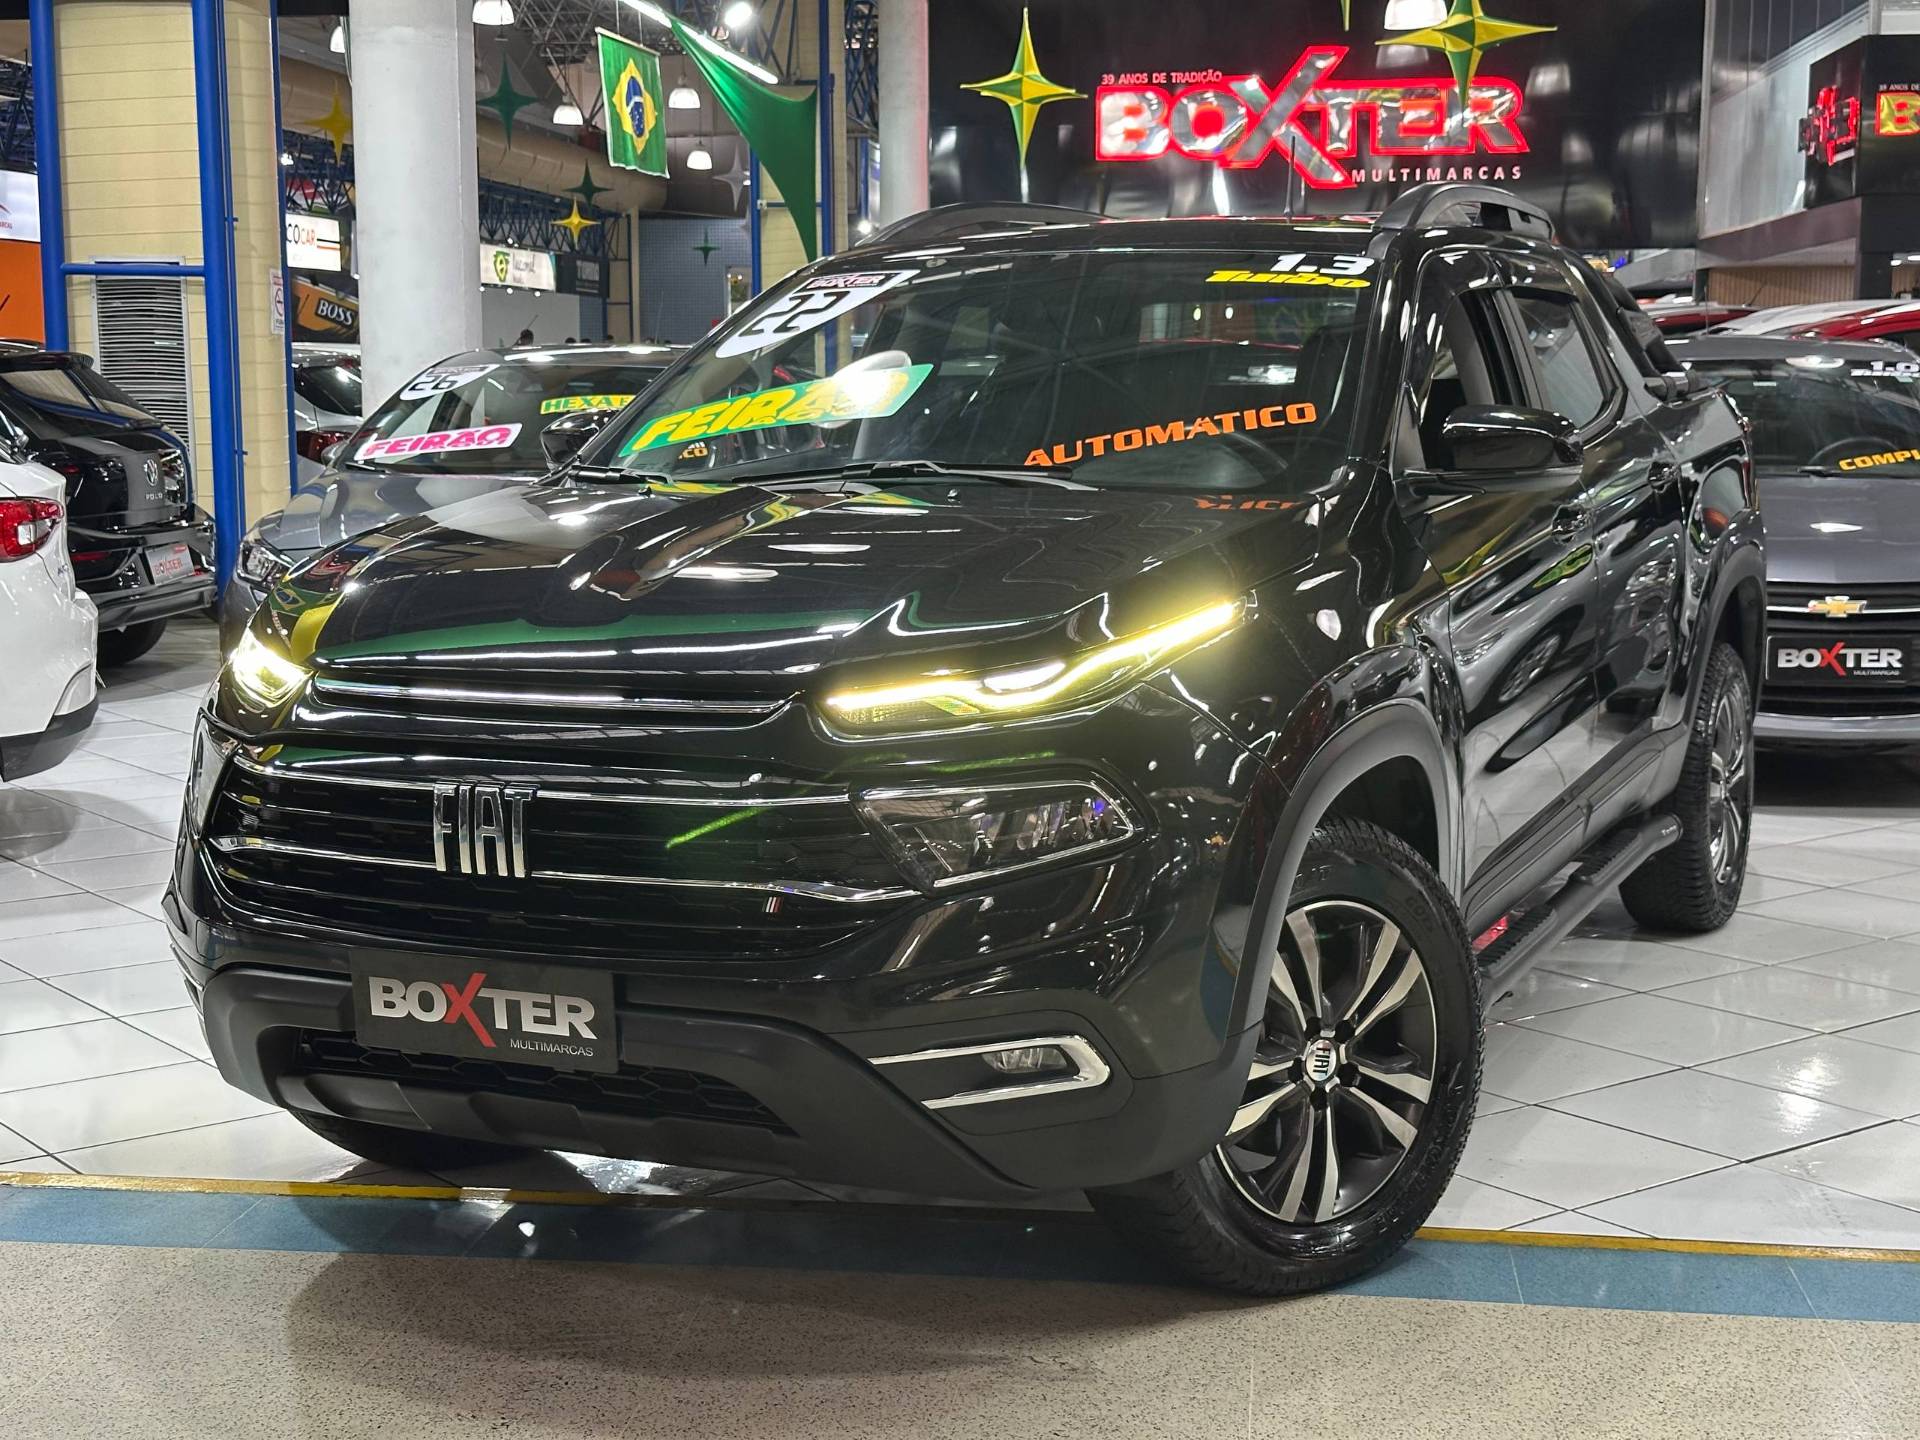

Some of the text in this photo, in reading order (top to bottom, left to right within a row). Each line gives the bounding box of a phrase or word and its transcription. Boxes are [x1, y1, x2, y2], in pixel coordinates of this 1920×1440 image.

[1101, 69, 1222, 85] 39 ANOS DE TRADIÇÃO
[1096, 46, 1529, 189] BOXTER
[1351, 166, 1522, 183] MULTIMARCAS
[1270, 253, 1375, 276] 1.3
[1205, 270, 1371, 288] Turbo
[317, 299, 353, 325] BOSS
[738, 290, 850, 337] 22
[1777, 641, 1903, 676] BOXTER
[433, 783, 534, 878] FIAT
[368, 972, 598, 1048] BOXTER
[510, 1038, 594, 1057] MULTIMARCAS
[1312, 1047, 1331, 1076] FIAT
